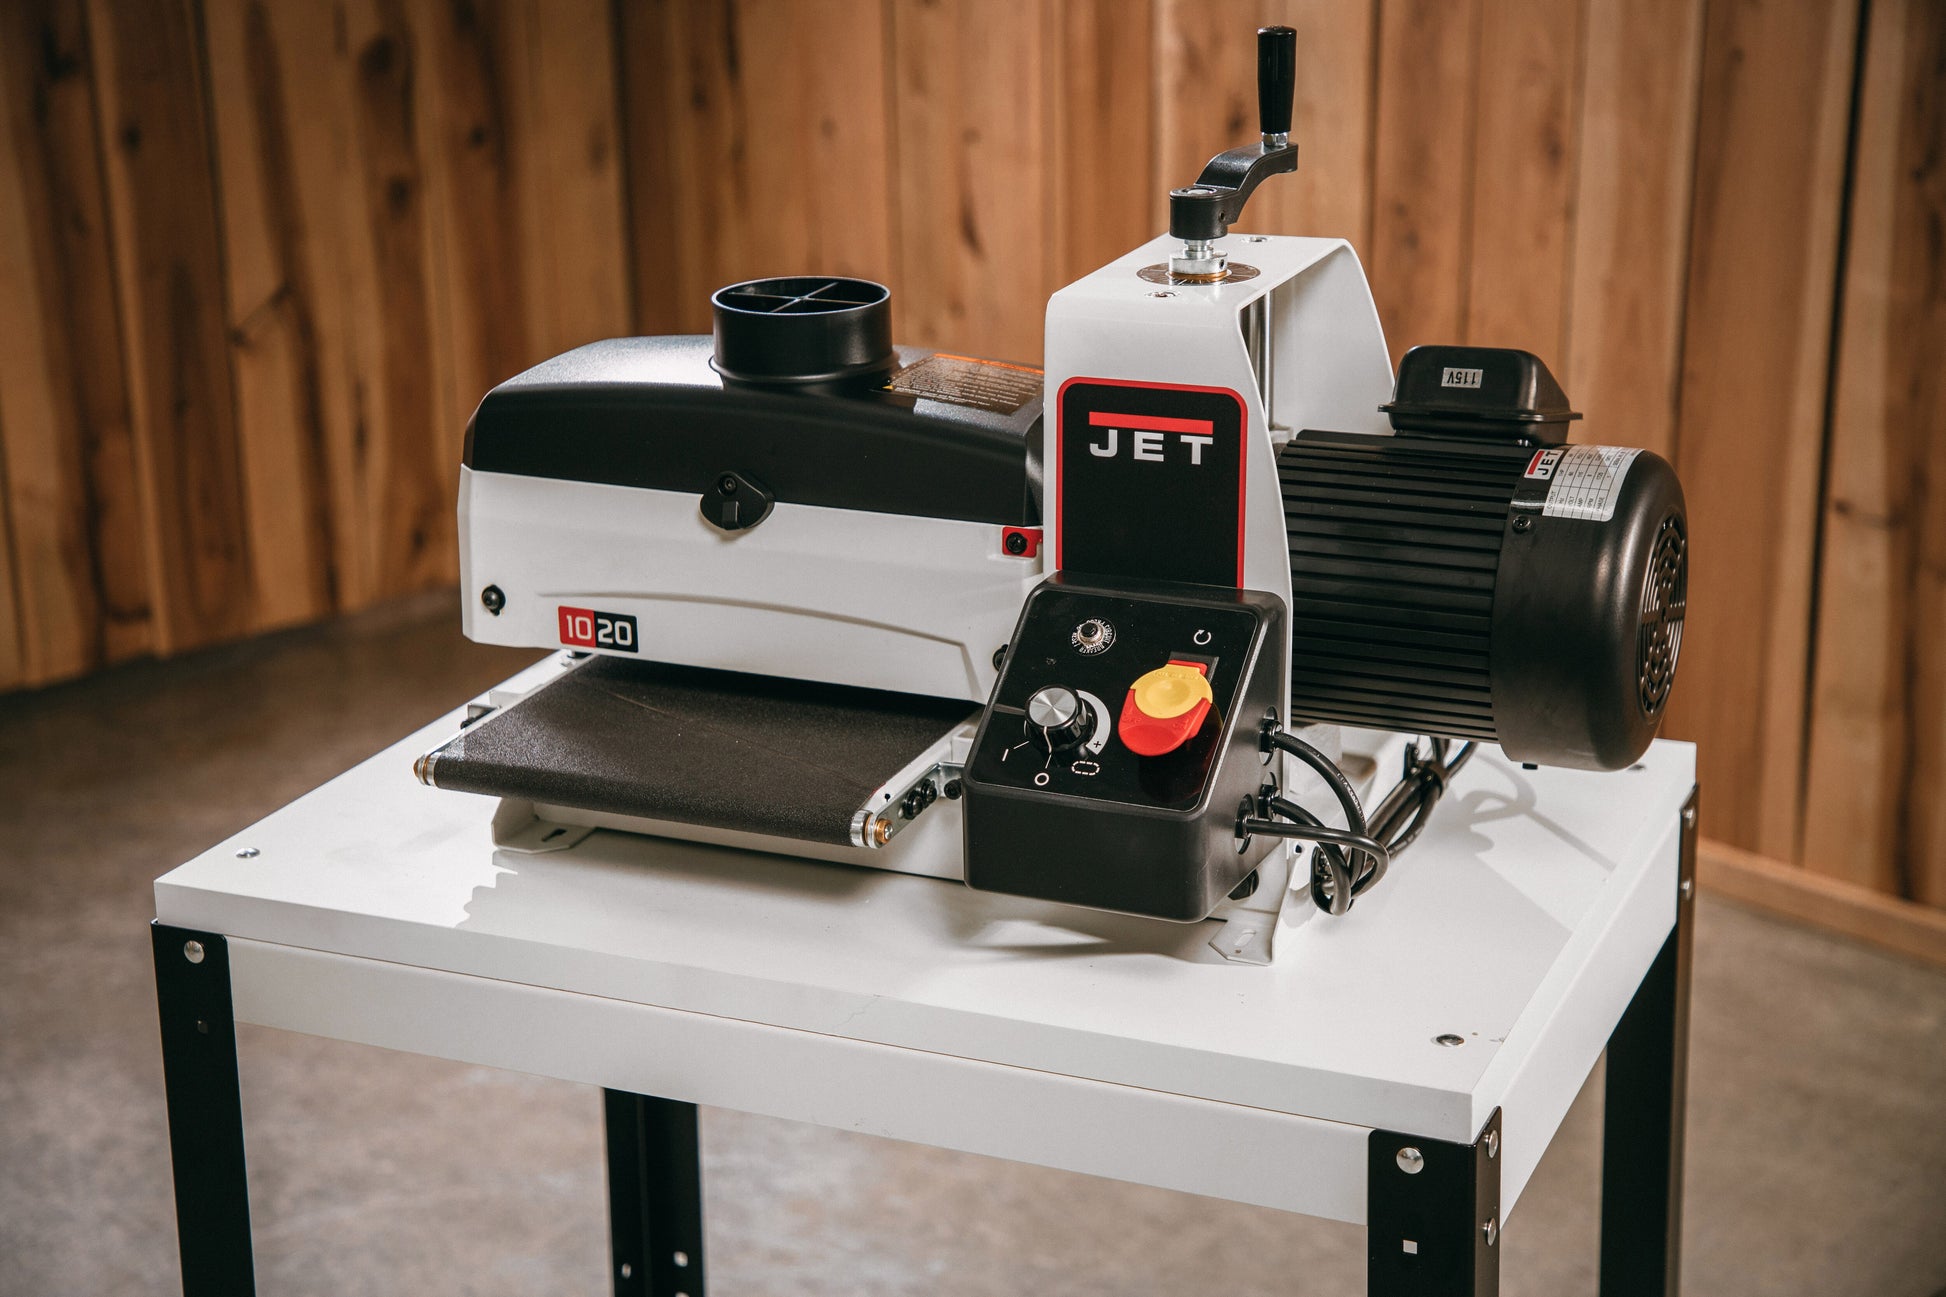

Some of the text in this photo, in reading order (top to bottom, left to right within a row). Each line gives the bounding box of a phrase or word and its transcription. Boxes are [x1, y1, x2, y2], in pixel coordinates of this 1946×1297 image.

[1447, 371, 1476, 384] 115V
[1089, 429, 1213, 465] JET
[1538, 451, 1558, 475] JET
